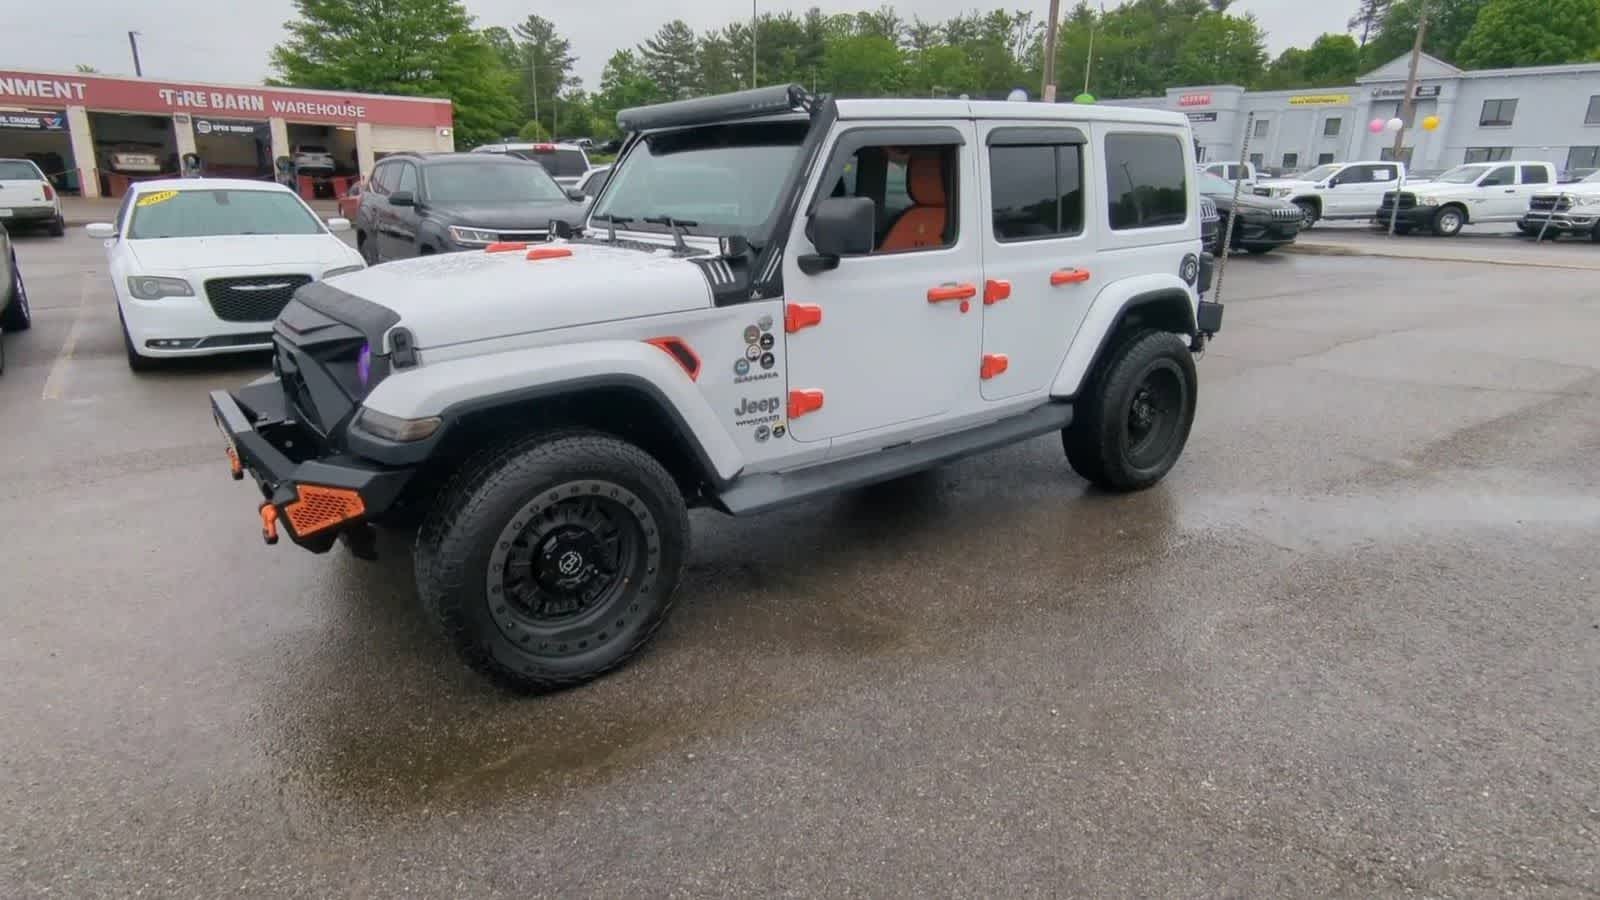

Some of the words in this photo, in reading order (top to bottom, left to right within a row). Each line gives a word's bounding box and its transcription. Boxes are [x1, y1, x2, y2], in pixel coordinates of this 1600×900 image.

[211, 92, 265, 112] BARN
[272, 100, 366, 118] WAREHOUSE
[734, 397, 780, 416] Jeep
